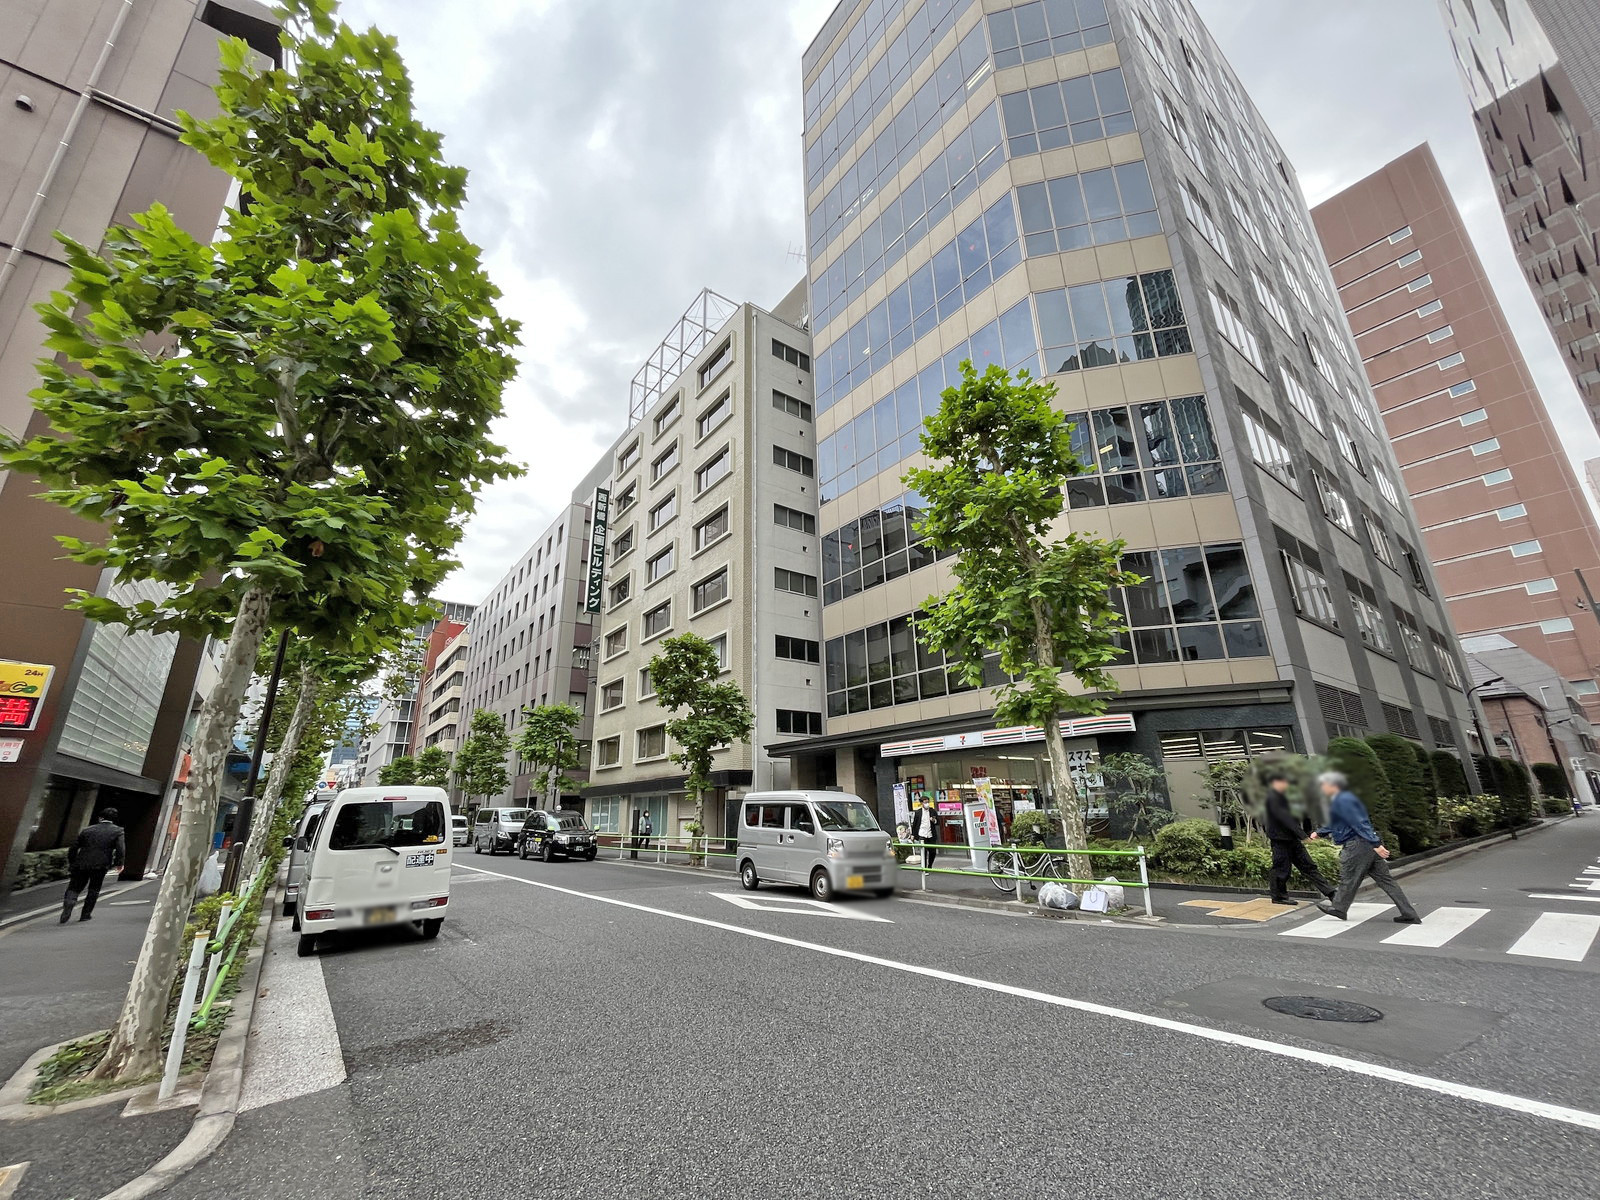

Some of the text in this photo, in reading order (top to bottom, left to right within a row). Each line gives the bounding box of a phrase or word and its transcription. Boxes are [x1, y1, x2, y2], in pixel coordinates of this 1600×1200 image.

[959, 735, 966, 745] 7
[1068, 750, 1092, 761] スマス
[973, 810, 986, 836] 7
[406, 854, 434, 865] 配達中
